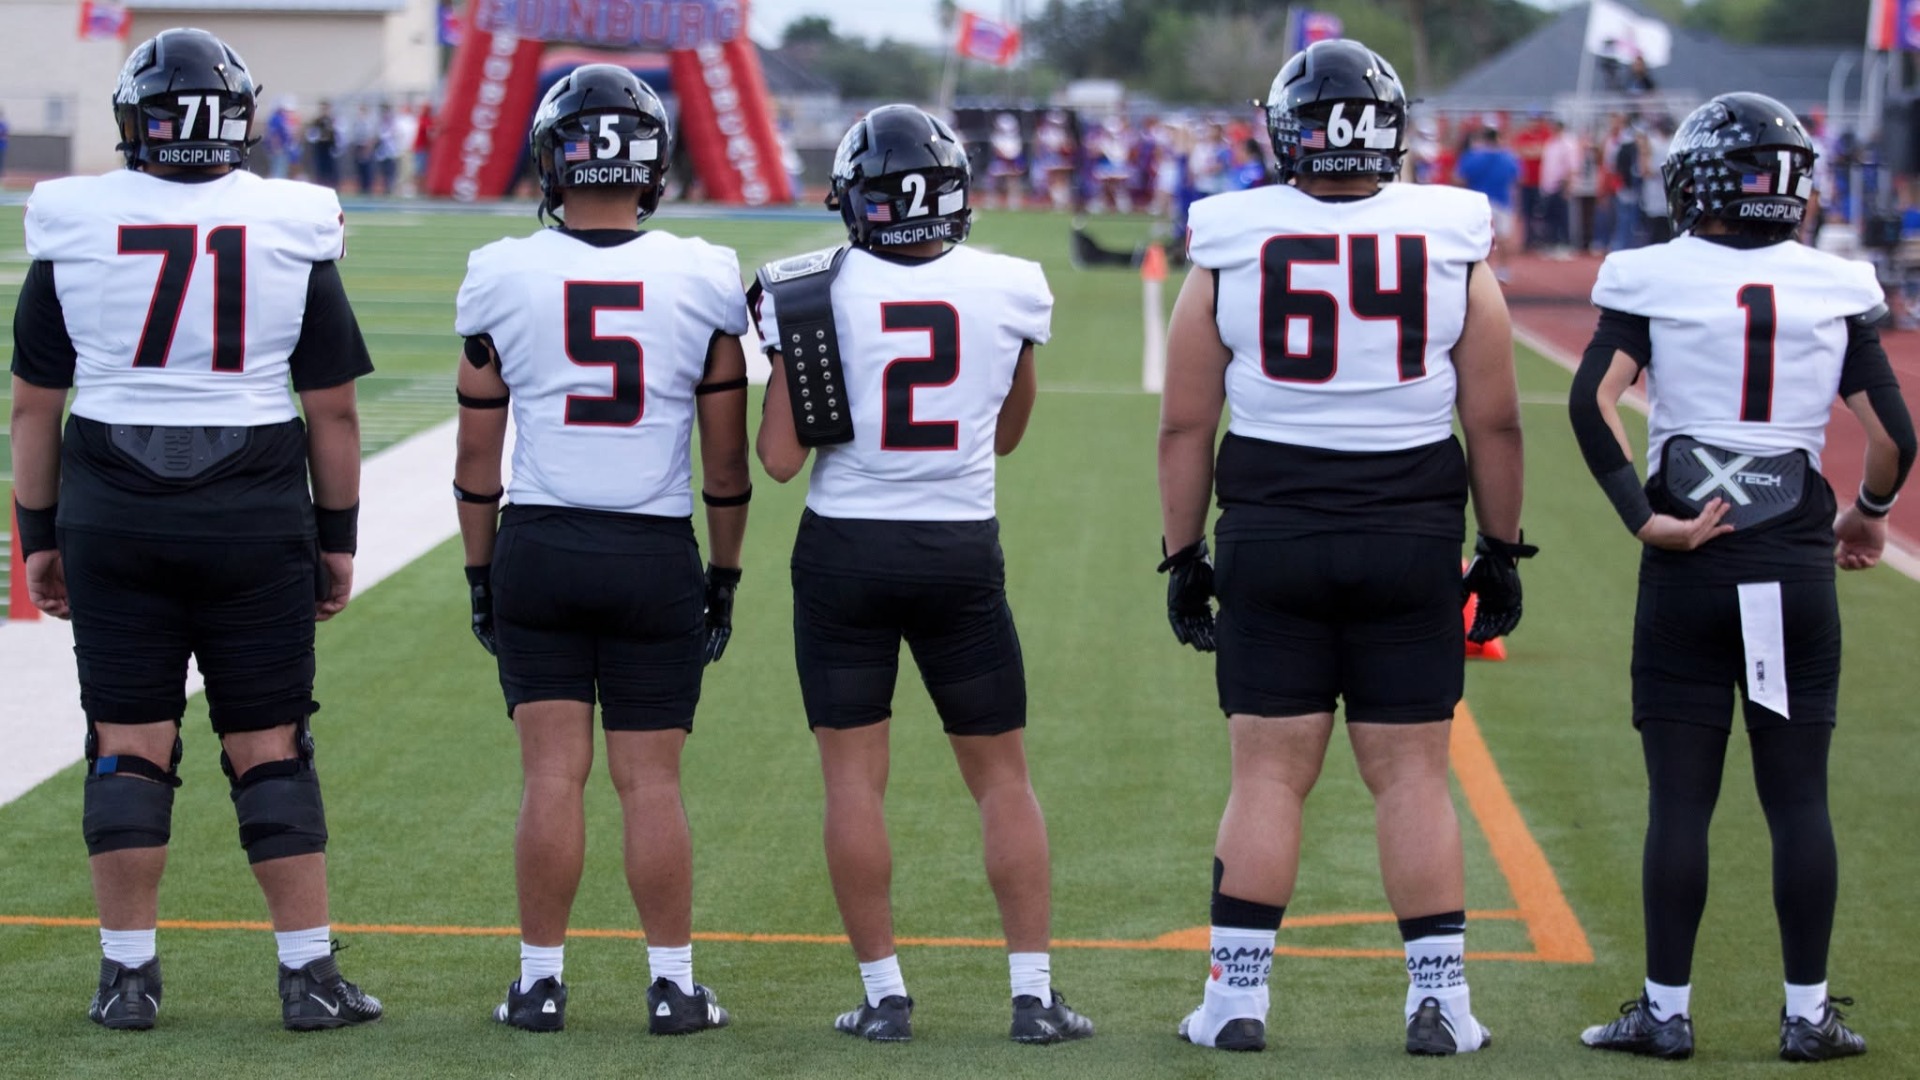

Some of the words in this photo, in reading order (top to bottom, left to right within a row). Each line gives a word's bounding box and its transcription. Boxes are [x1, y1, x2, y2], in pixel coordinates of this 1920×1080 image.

[177, 95, 220, 140] 71
[453, 28, 520, 202] BOBCATS
[597, 114, 621, 160] 5
[1327, 102, 1376, 148] 64
[159, 149, 230, 163] DISCIPLINE
[575, 167, 650, 184] DISCIPLINE
[1312, 157, 1383, 172] DISCIPLINE
[1777, 150, 1791, 195] 1
[901, 173, 929, 218] 2
[1739, 203, 1803, 219] DISCIPLINE
[881, 224, 952, 245] DISCIPLINE
[117, 224, 246, 373] 71
[1259, 234, 1427, 384] 64
[564, 280, 644, 427] 5
[1737, 283, 1776, 422] 1
[880, 301, 960, 450] 2
[1210, 946, 1274, 962] OMM
[1225, 963, 1261, 974] THIS
[1412, 971, 1445, 981] THIS
[1228, 976, 1260, 987] FOR
